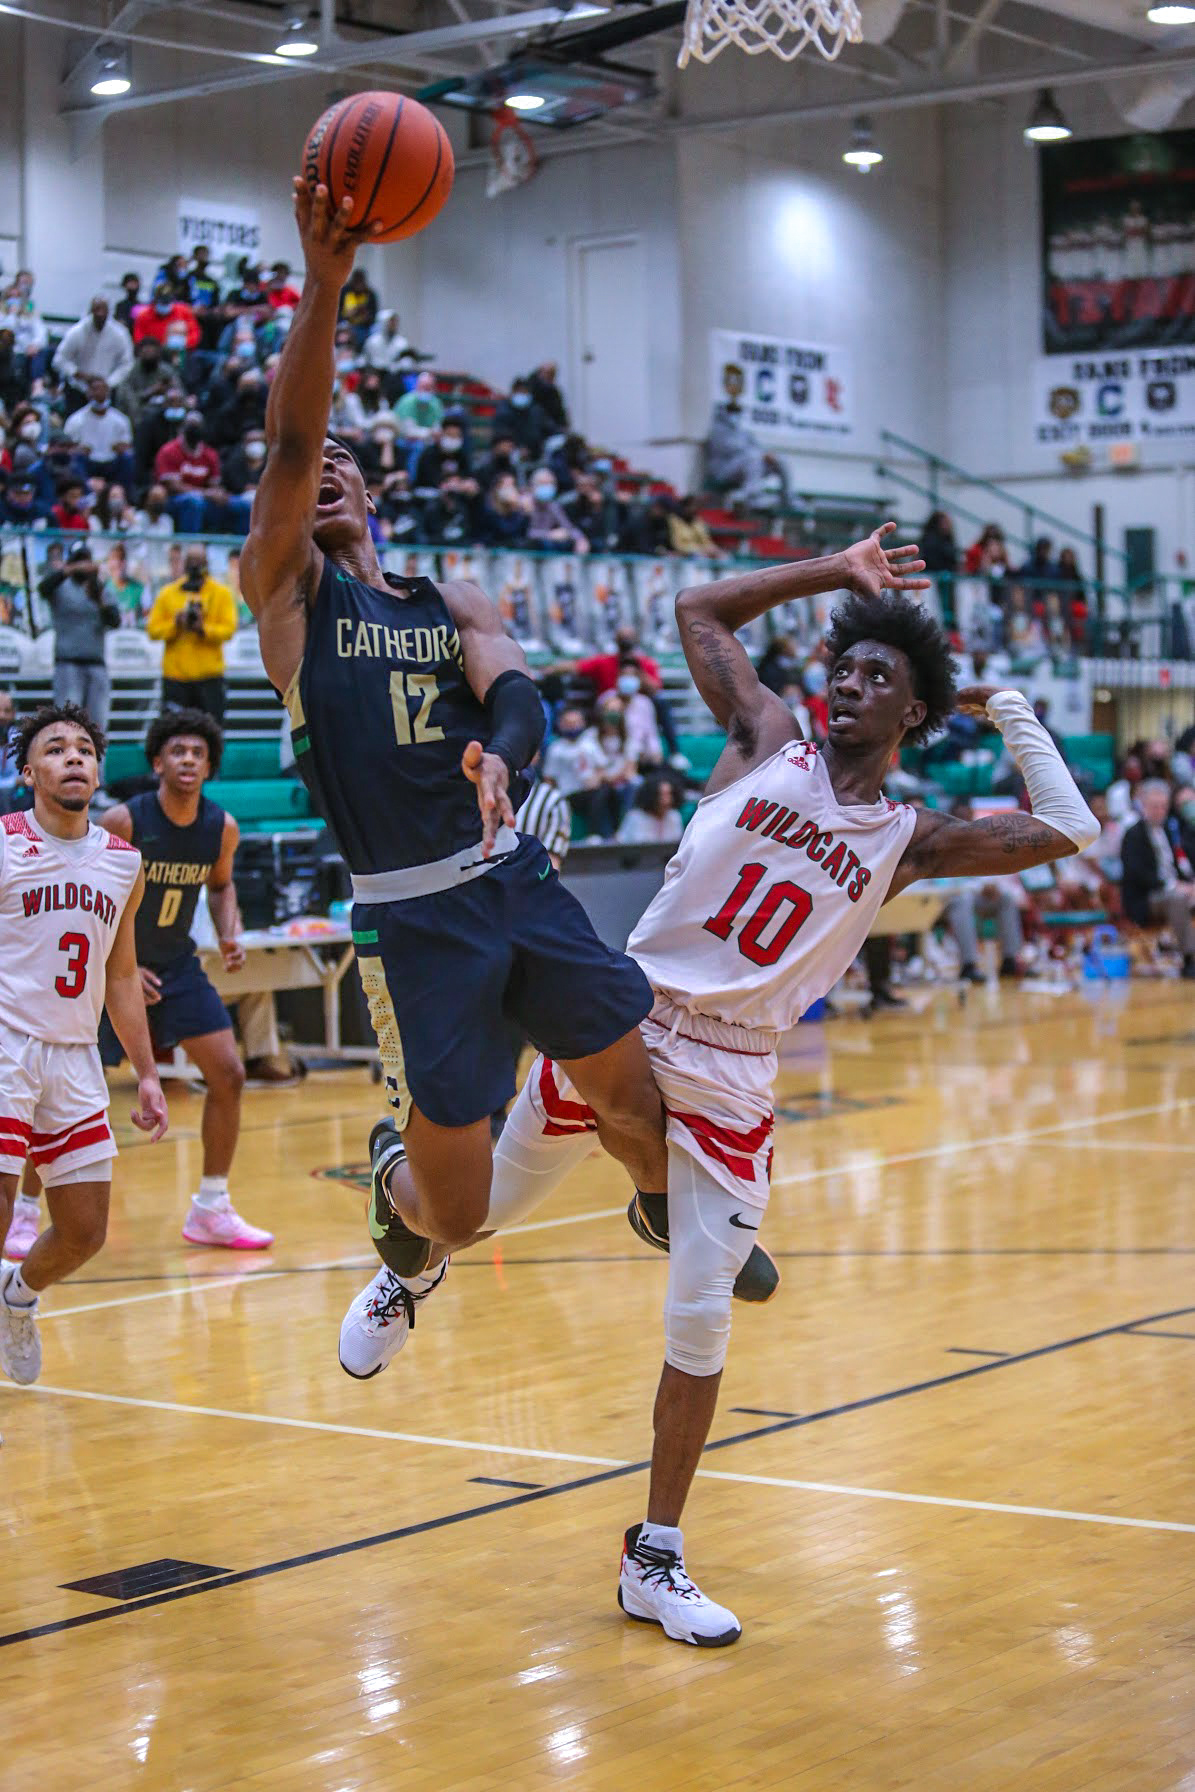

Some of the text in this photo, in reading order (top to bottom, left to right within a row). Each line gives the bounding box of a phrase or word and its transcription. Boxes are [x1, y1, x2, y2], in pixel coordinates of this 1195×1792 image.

[180, 217, 260, 248] VISITORS
[337, 618, 463, 670] CATHEDRA
[389, 670, 446, 746] 12
[735, 796, 872, 903] WILDCATS
[157, 888, 183, 928] 0
[702, 862, 814, 967] 10
[55, 931, 90, 999] 3
